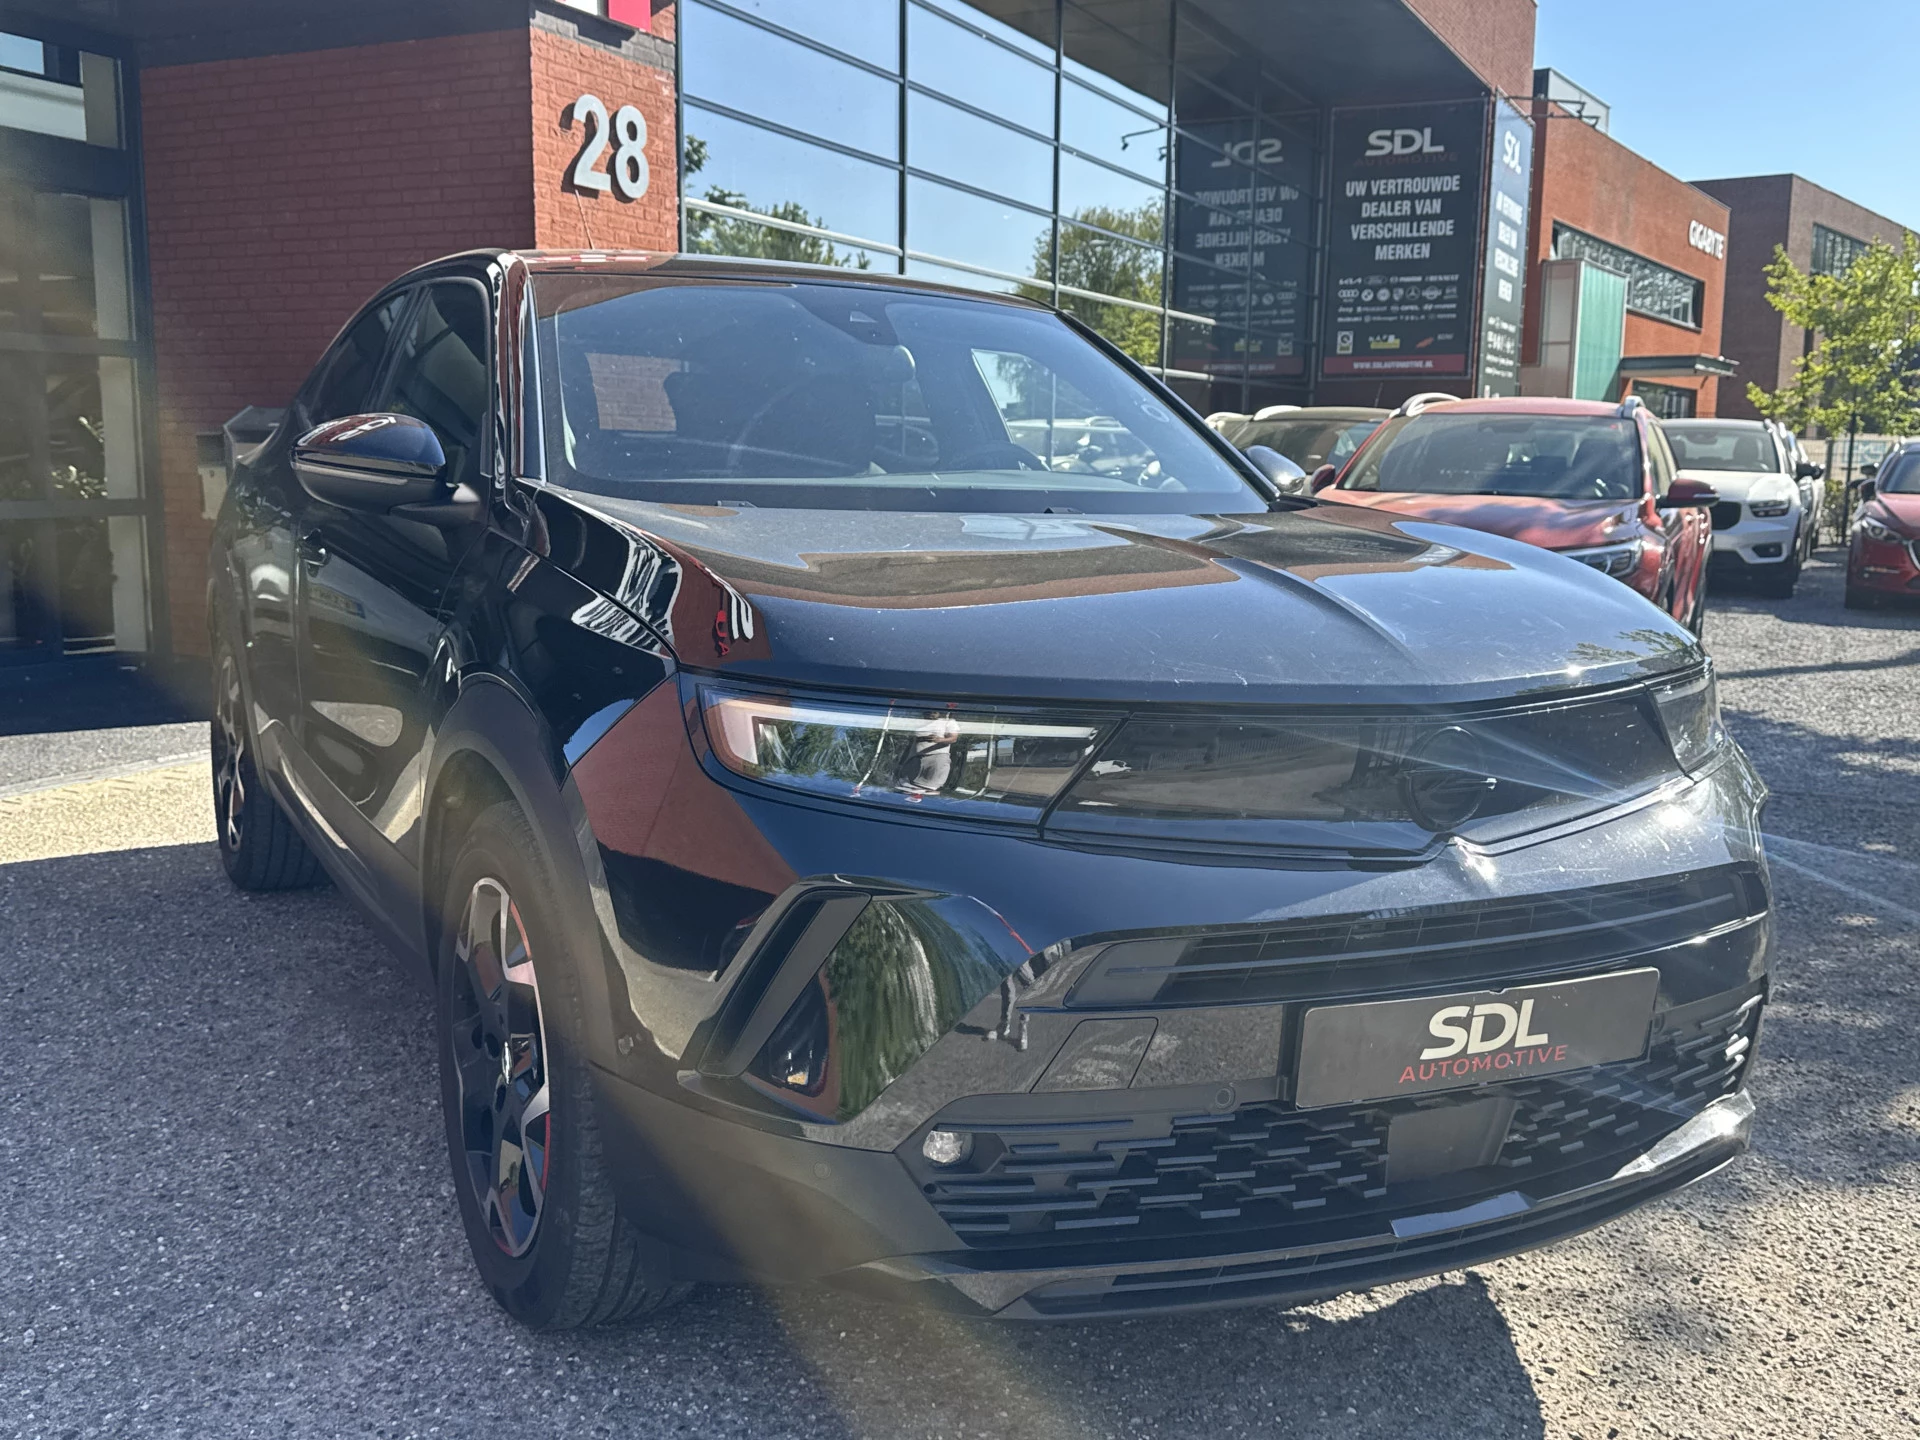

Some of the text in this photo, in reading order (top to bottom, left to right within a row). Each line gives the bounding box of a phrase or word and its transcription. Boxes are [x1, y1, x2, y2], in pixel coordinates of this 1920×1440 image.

[572, 94, 650, 200] 28
[1365, 127, 1444, 156] SDL
[1345, 175, 1460, 197] UW VERTROUWDE
[1361, 198, 1442, 218] DEALER VAN
[1351, 219, 1455, 240] VERSCHILLENDE
[1375, 242, 1431, 260] MERKEN
[1419, 999, 1549, 1060] SDL
[1399, 1045, 1568, 1084] AUTOMOTIVE
